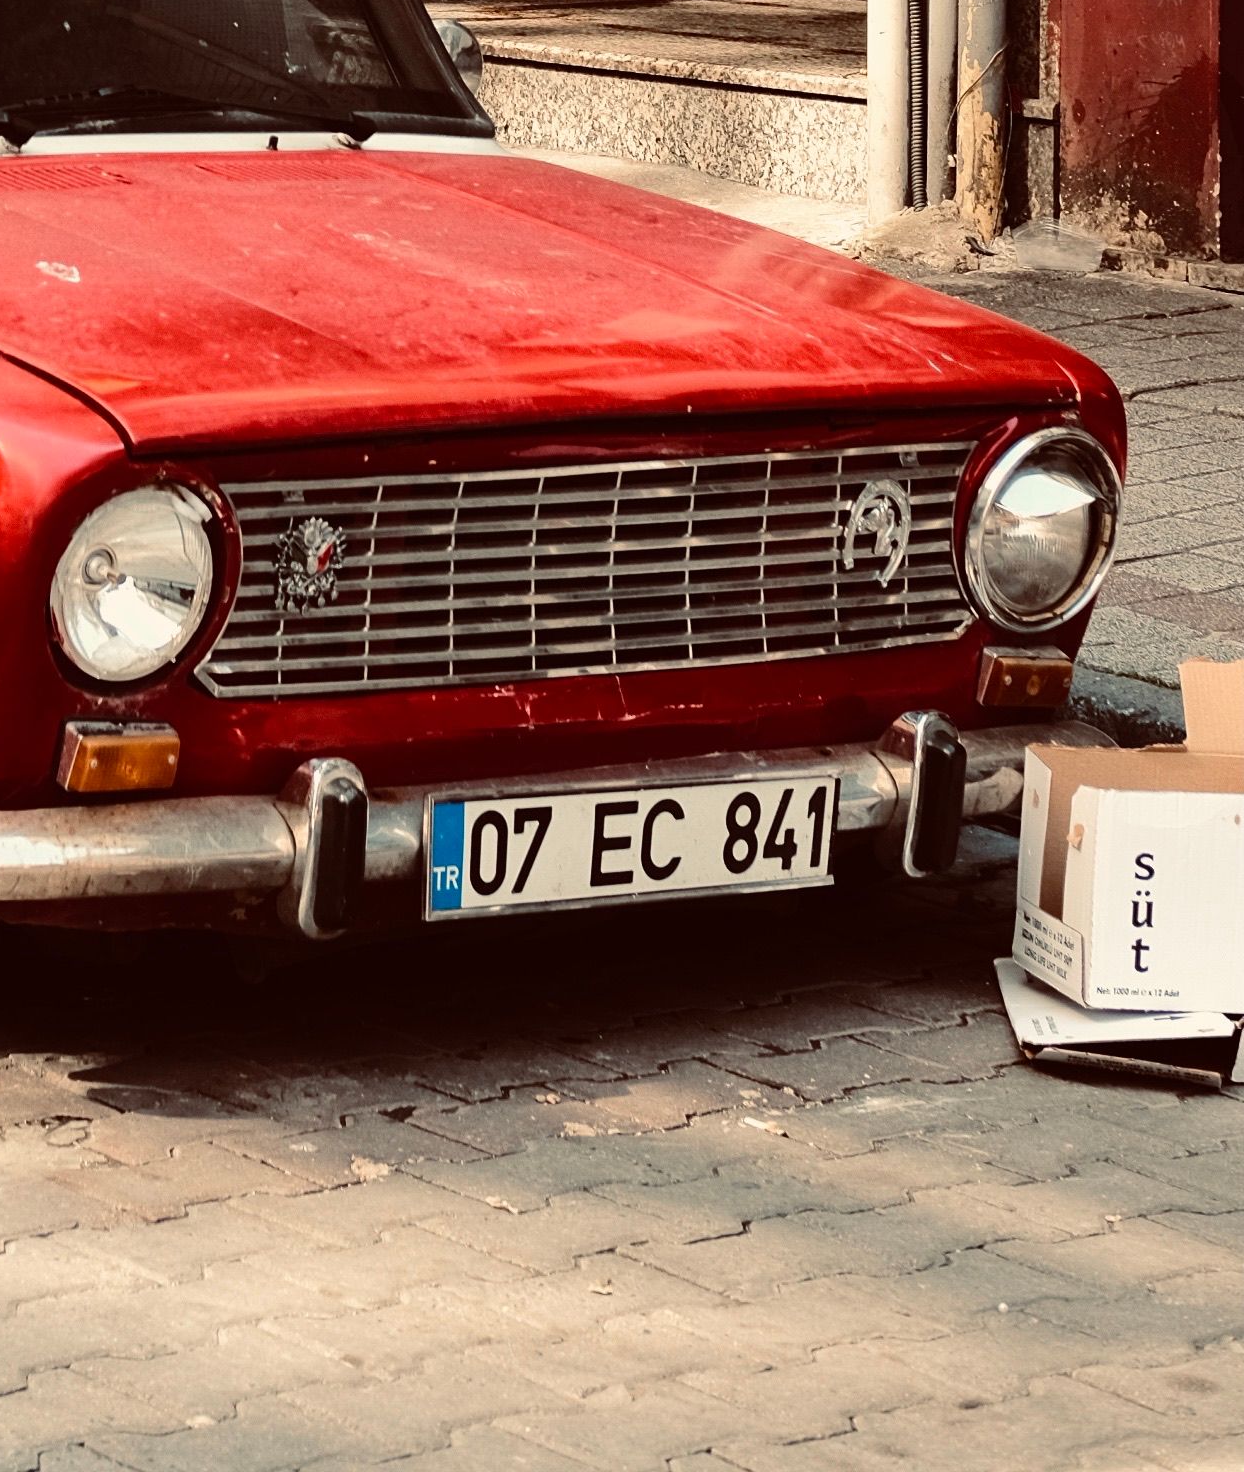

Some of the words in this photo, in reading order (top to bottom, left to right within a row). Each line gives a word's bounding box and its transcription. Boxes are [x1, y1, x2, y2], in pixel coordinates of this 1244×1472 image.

[432, 865, 460, 892] TR
[469, 805, 554, 897] 07
[589, 798, 686, 888] EC
[722, 786, 828, 876] 841
